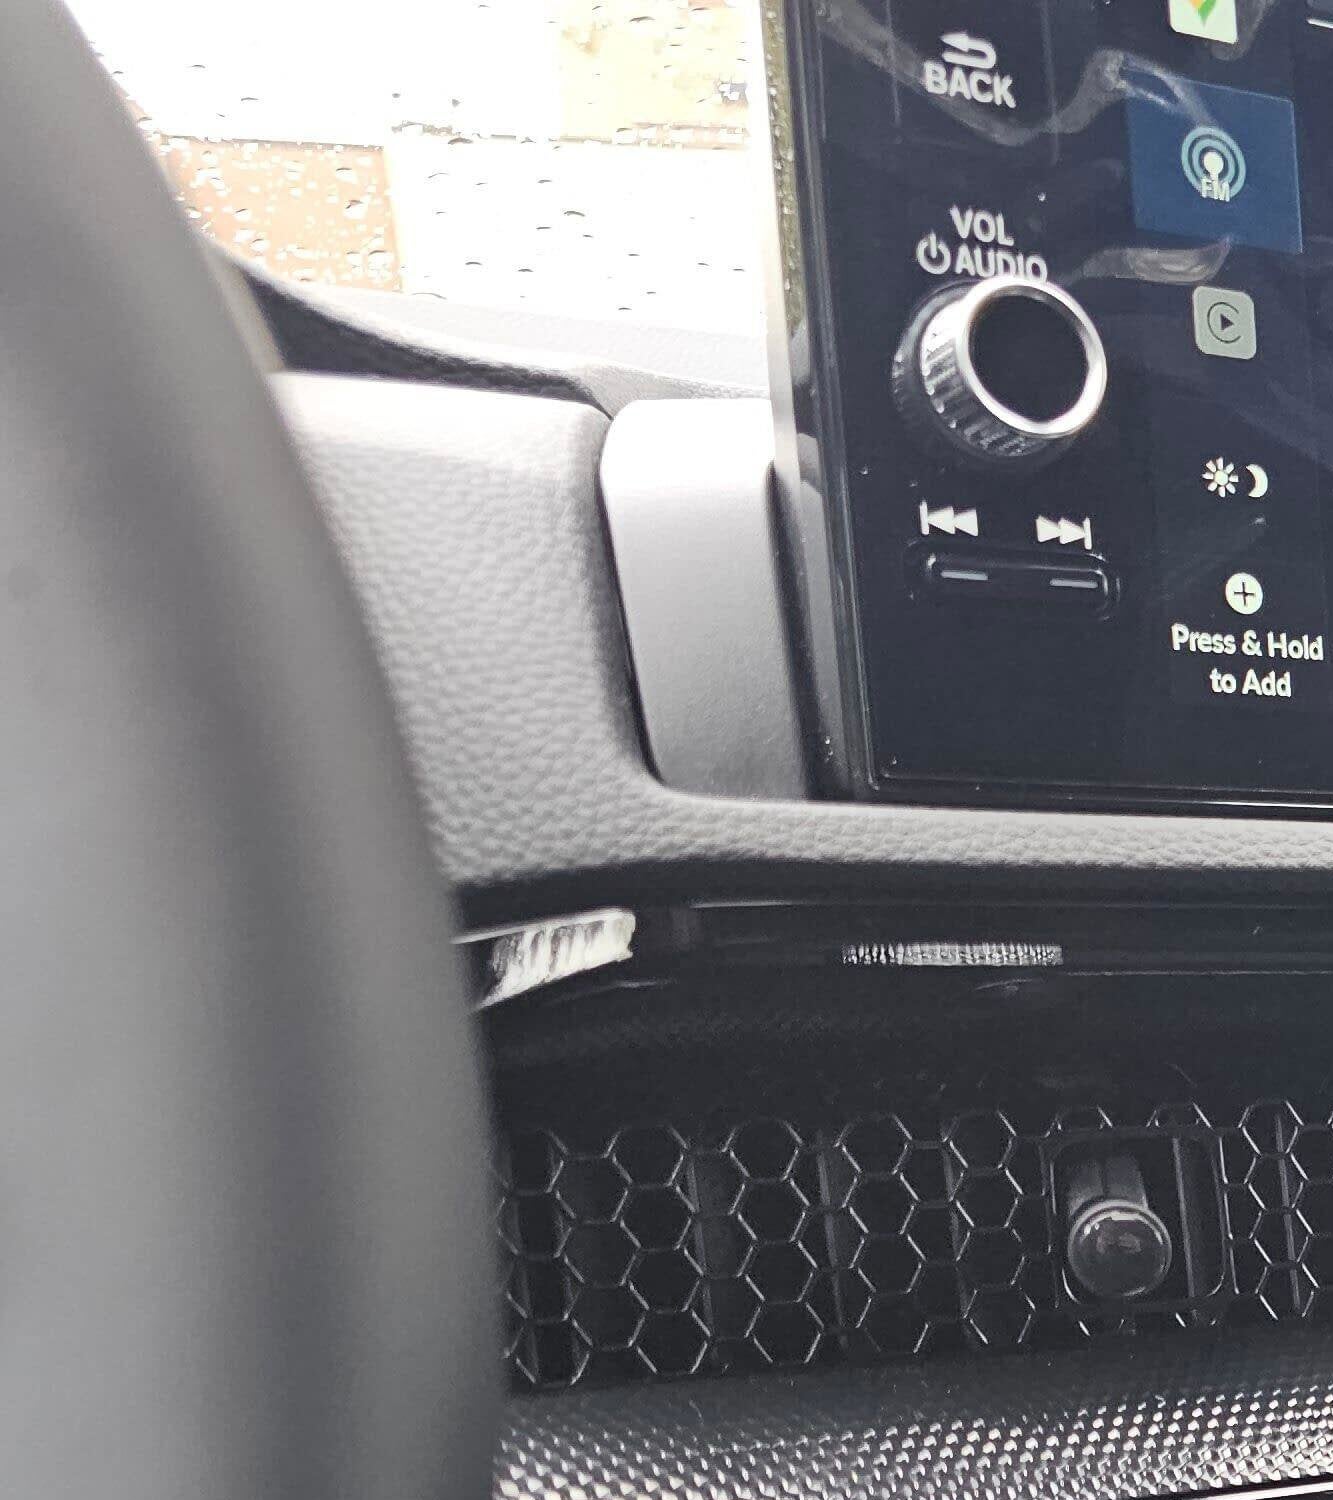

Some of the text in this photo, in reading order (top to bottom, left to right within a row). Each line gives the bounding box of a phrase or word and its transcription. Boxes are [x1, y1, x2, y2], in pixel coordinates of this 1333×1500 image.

[923, 59, 1017, 108] BACK
[1201, 177, 1231, 202] FM
[950, 205, 1015, 247] VOL
[954, 243, 1048, 283] AUDIO
[1171, 622, 1324, 661] Press & Hold
[1209, 667, 1292, 697] to Add
